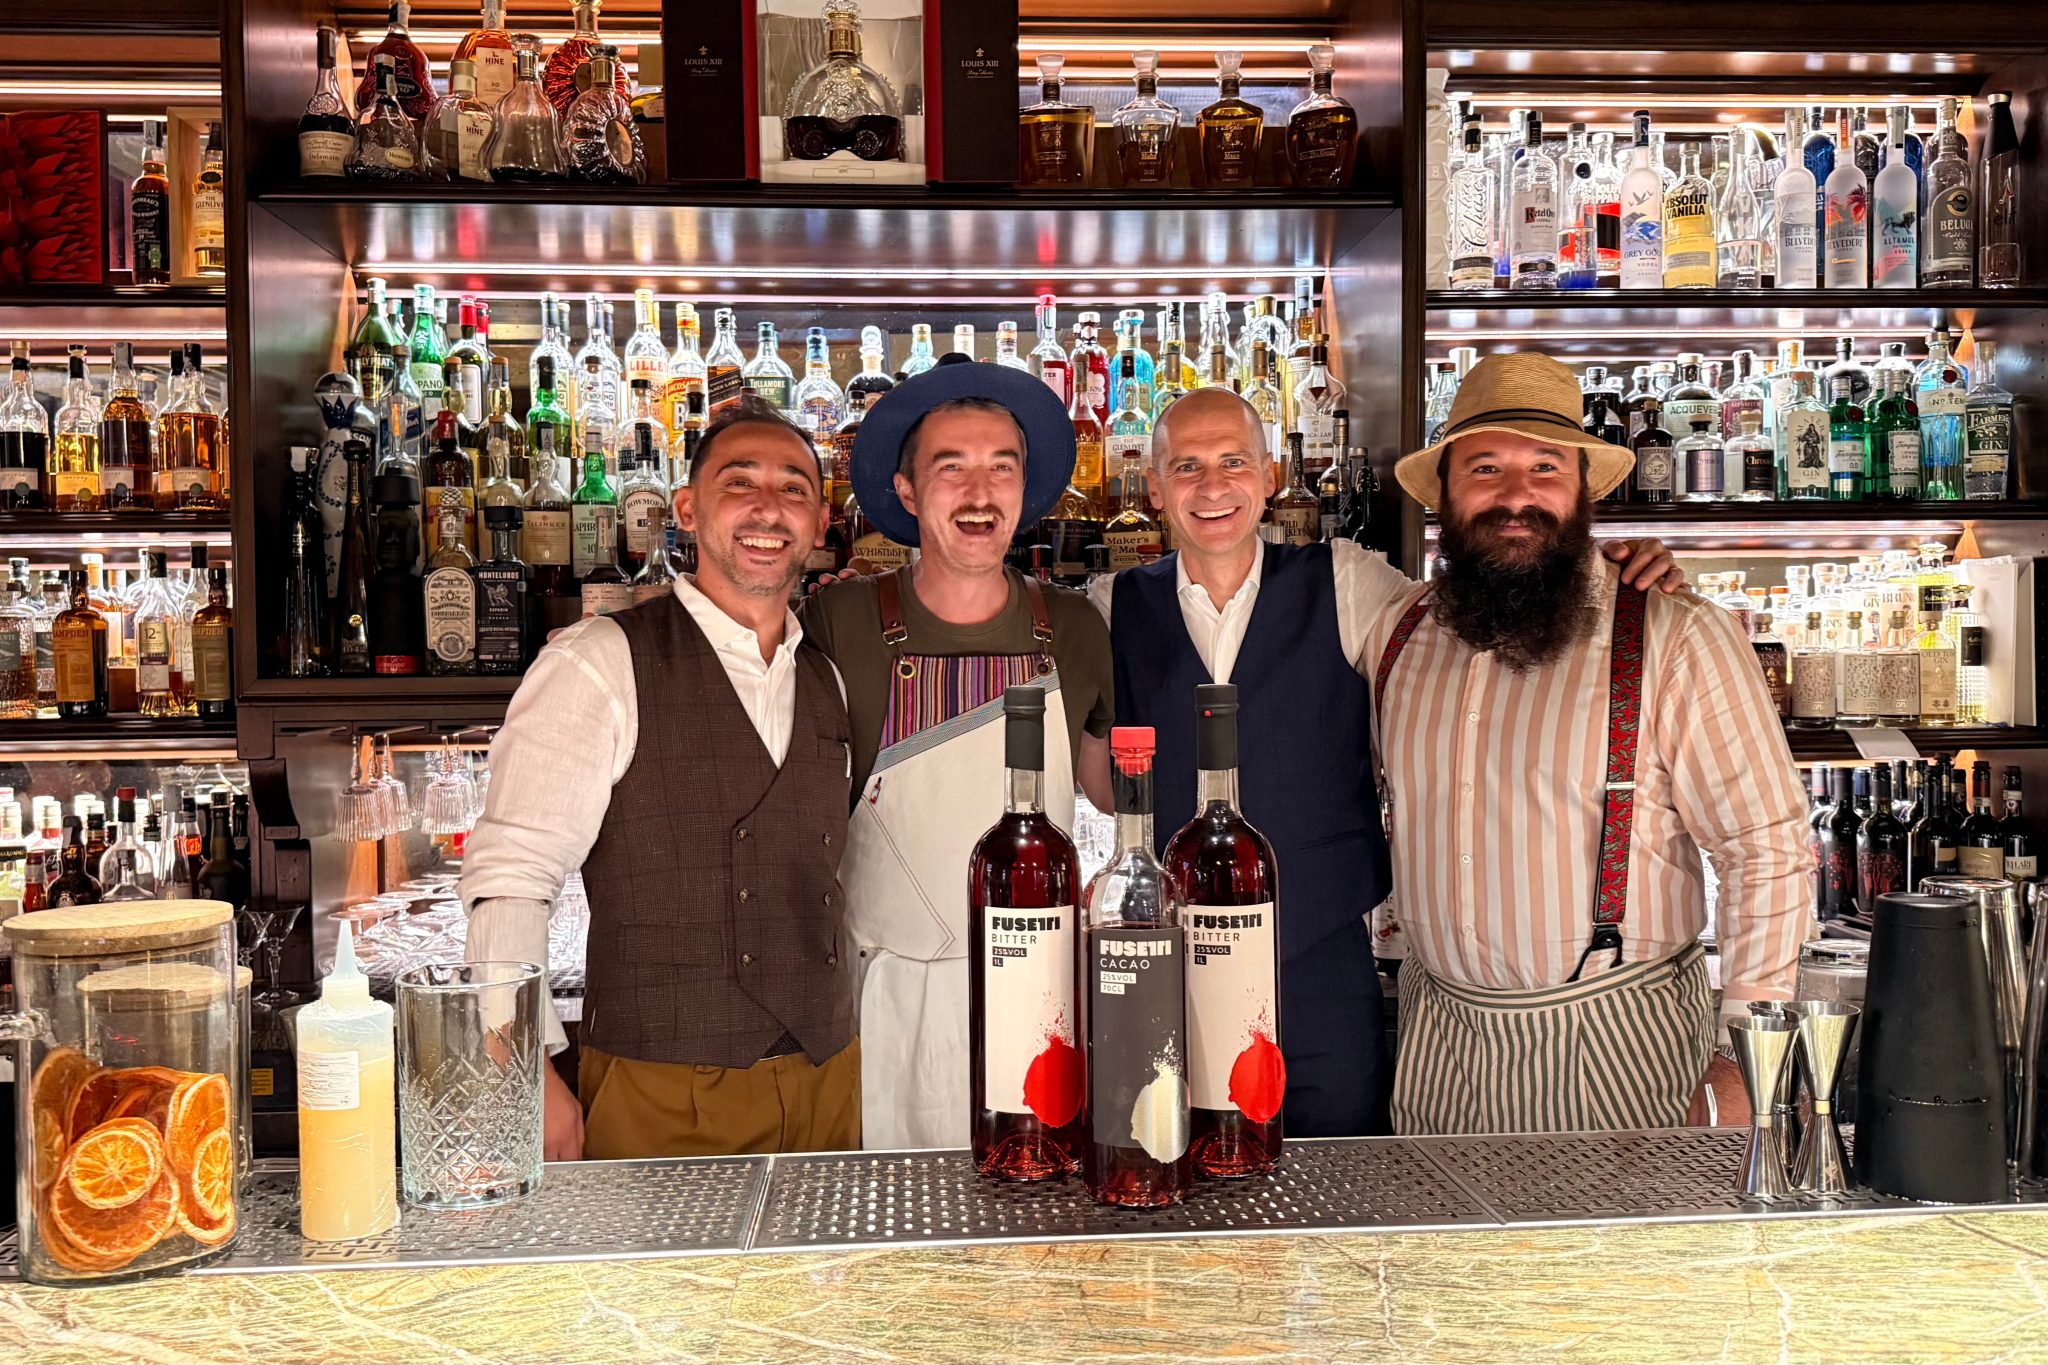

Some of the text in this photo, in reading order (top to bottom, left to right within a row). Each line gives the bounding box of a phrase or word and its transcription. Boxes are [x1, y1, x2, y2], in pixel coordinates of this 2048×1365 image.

[485, 57, 505, 65] HINE
[466, 126, 484, 136] HINE
[195, 201, 224, 209] GLENLIV
[1665, 194, 1709, 210] ABSOLUT
[1525, 207, 1546, 223] Ketel
[1666, 204, 1706, 220] VANILIA
[1624, 249, 1643, 259] GREY
[750, 379, 785, 388] TULLAMORE
[760, 388, 775, 396] DEW
[1949, 397, 1964, 405] TEN
[1112, 444, 1145, 452] GLENLIVET
[1979, 441, 2003, 450] GIN
[1107, 536, 1149, 545] Maker's
[1119, 546, 1137, 554] Ma
[144, 628, 156, 639] 12
[992, 916, 1060, 931] FUSETTI
[1193, 913, 1262, 929] FUSETTI
[991, 933, 1037, 944] BITTER
[1193, 931, 1240, 942] BITTER
[1100, 939, 1171, 957] FUSETTI
[1100, 957, 1150, 970] CACAO
[1102, 984, 1122, 993] 70CL
